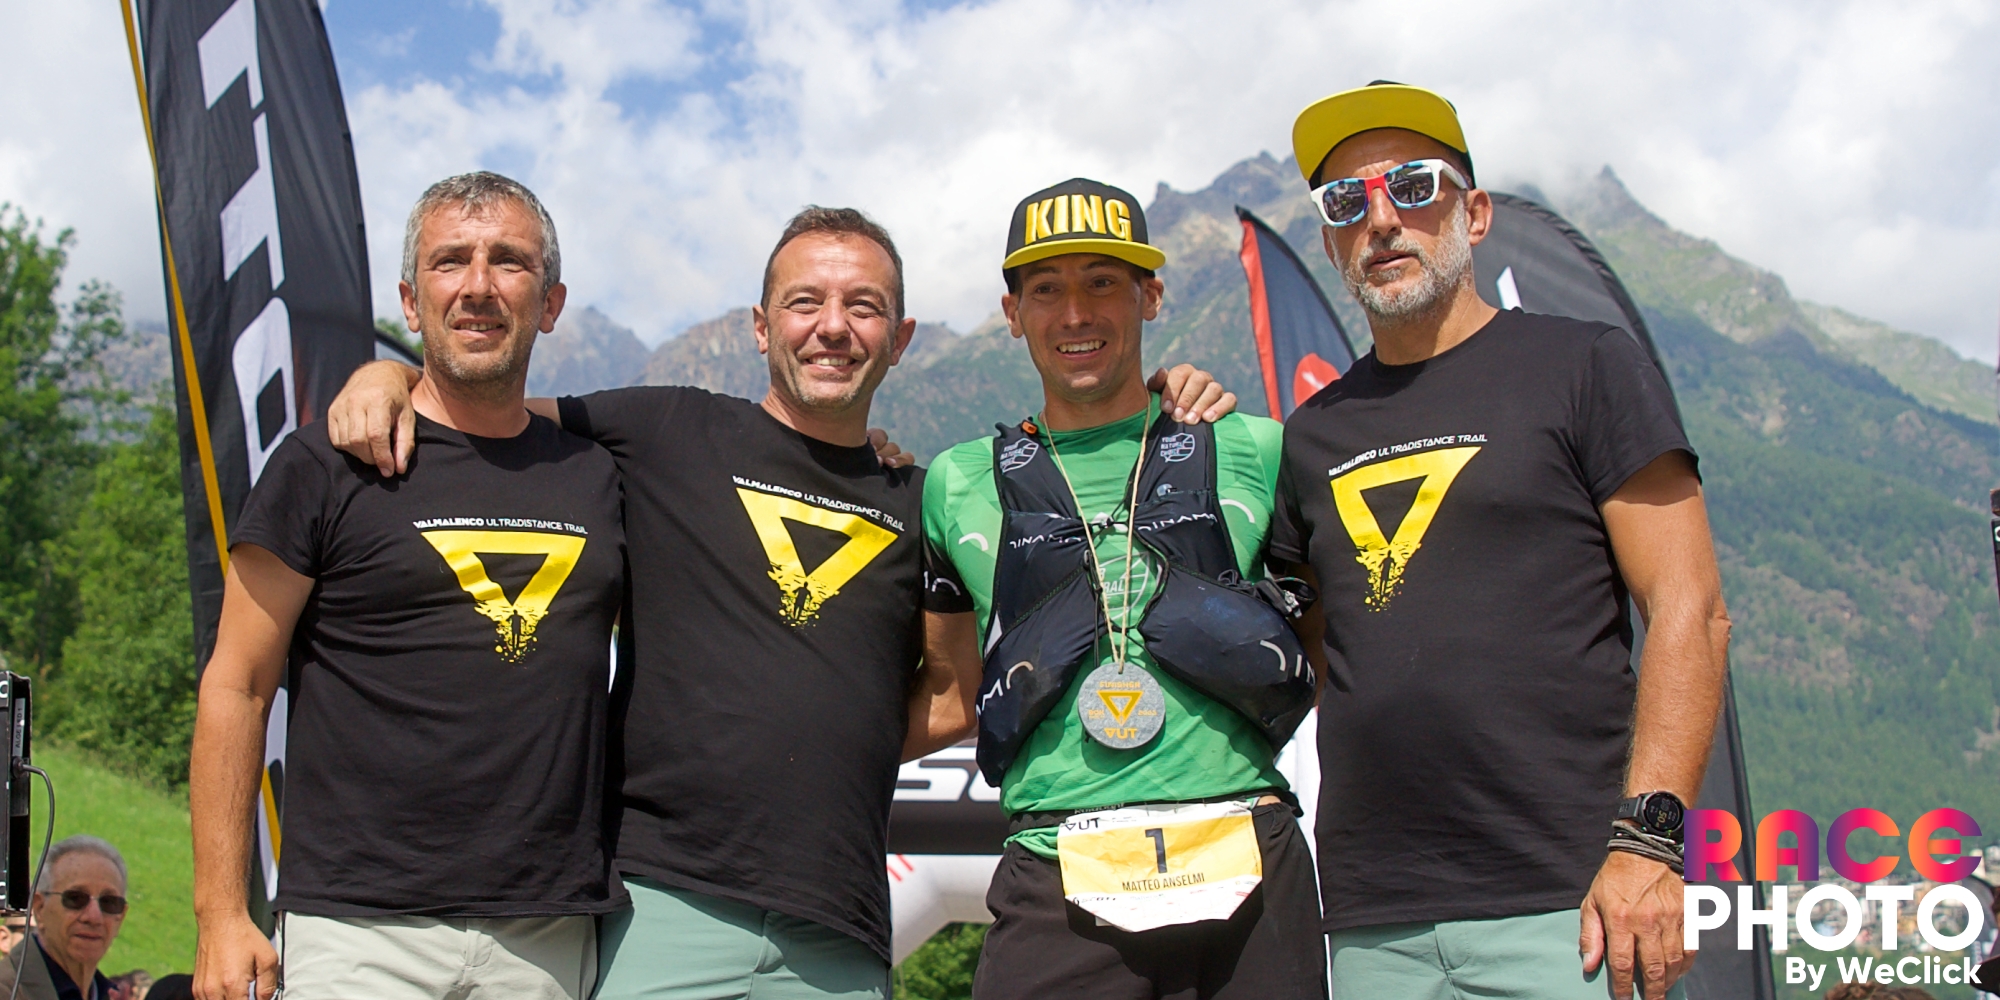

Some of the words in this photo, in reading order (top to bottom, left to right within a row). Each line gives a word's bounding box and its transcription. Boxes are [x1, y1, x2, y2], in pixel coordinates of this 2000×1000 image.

[1025, 194, 1133, 245] KING
[1328, 450, 1377, 476] VALMALENCO
[1378, 436, 1456, 457] ULTRADISTANCE
[1457, 434, 1488, 443] TRAIL
[732, 475, 802, 499] VALMALENCO
[804, 493, 882, 519] ULTRADISTANCE
[882, 513, 905, 531] TRAIL
[413, 517, 484, 529] VALMALENCO
[486, 518, 563, 530] ULTRADISTANCE
[564, 522, 588, 534] TRAIL
[1104, 727, 1138, 739] VUT
[1065, 816, 1100, 831] VUT
[1145, 827, 1168, 874] 1
[1121, 878, 1161, 892] MATTEO
[1162, 872, 1205, 889] ANSELMI
